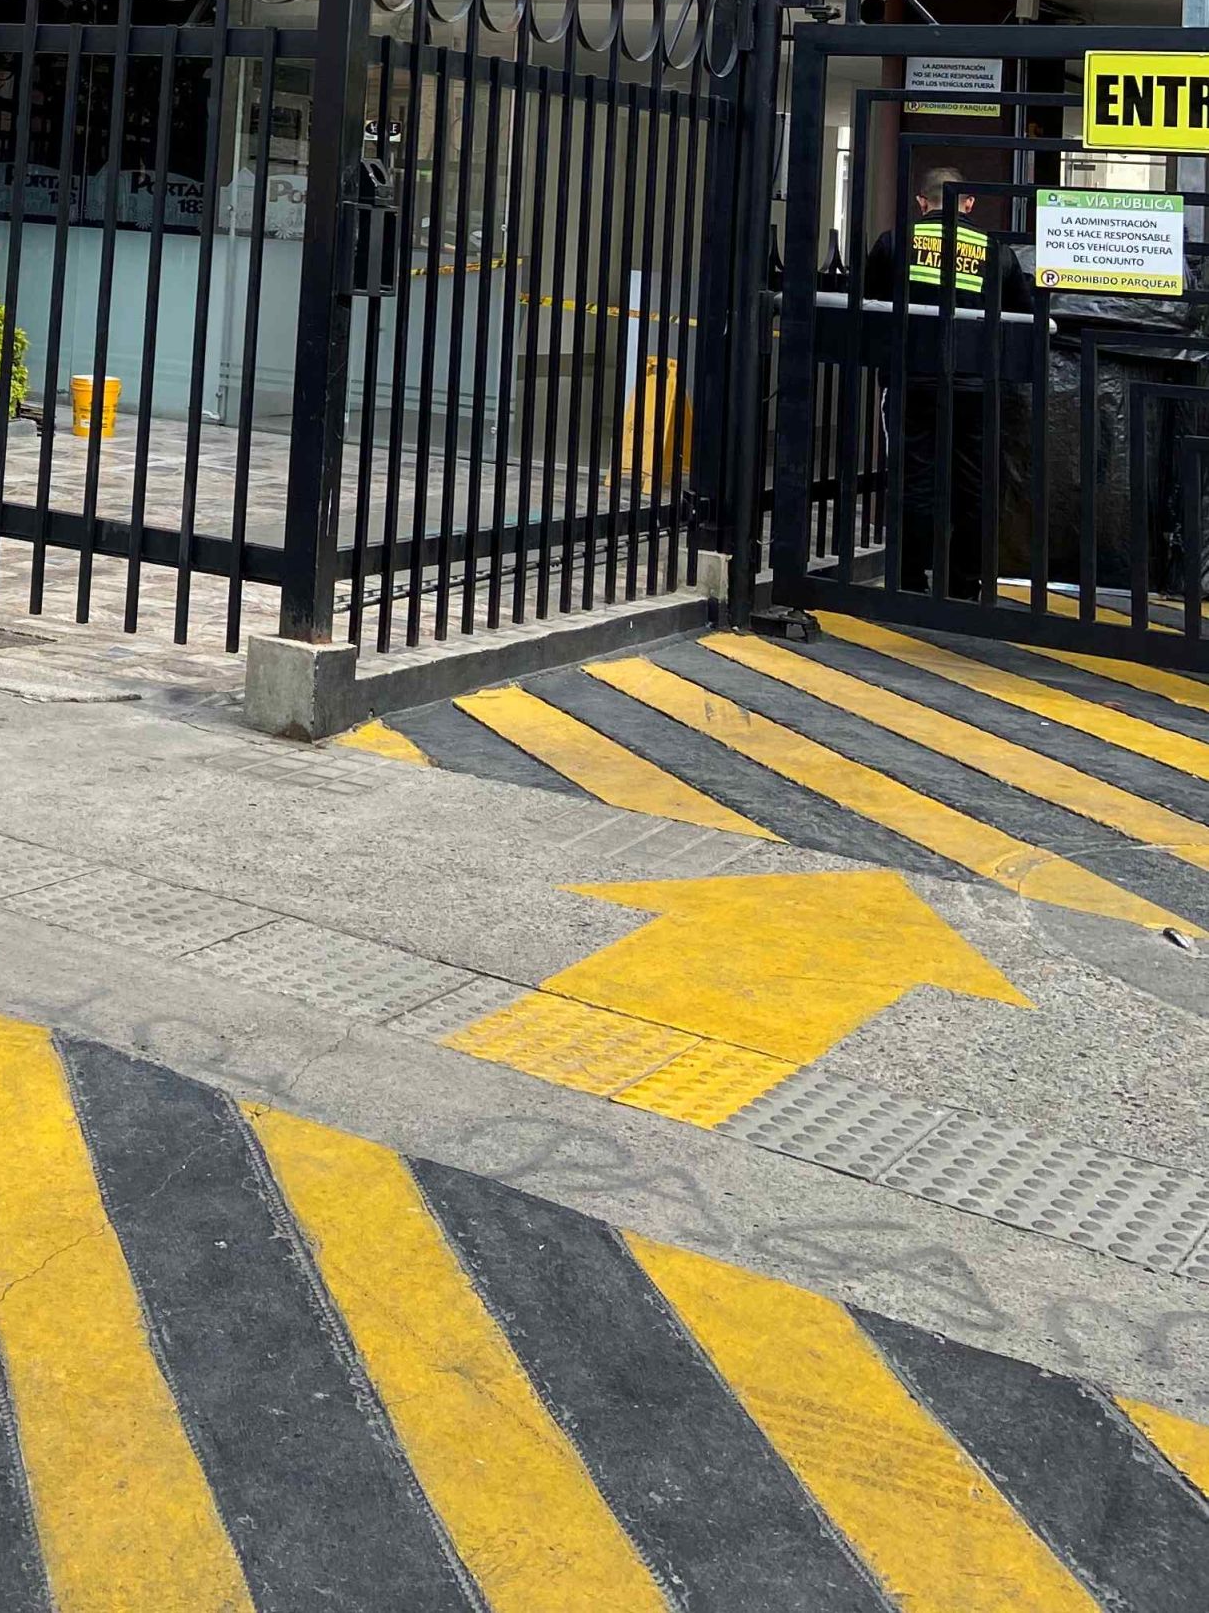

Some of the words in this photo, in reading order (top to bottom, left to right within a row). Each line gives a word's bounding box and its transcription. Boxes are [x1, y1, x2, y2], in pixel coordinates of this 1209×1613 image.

[1086, 194, 1109, 207] VÍA
[1113, 193, 1174, 210] PÚBLICA
[1075, 217, 1157, 228] ADMINISTRACIÓN
[1077, 230, 1101, 238] HACE
[1104, 232, 1170, 242] RESPONSABLE
[1046, 241, 1065, 249] POR
[1068, 242, 1085, 250] LOS
[1087, 242, 1139, 253] VEHÍCULOS
[1142, 246, 1173, 255] FUERA
[1073, 255, 1090, 263] DEL
[1093, 256, 1144, 266] CONJUNTO
[1061, 274, 1118, 285] PROHIBIDO
[1121, 279, 1177, 289] PARQUEAR
